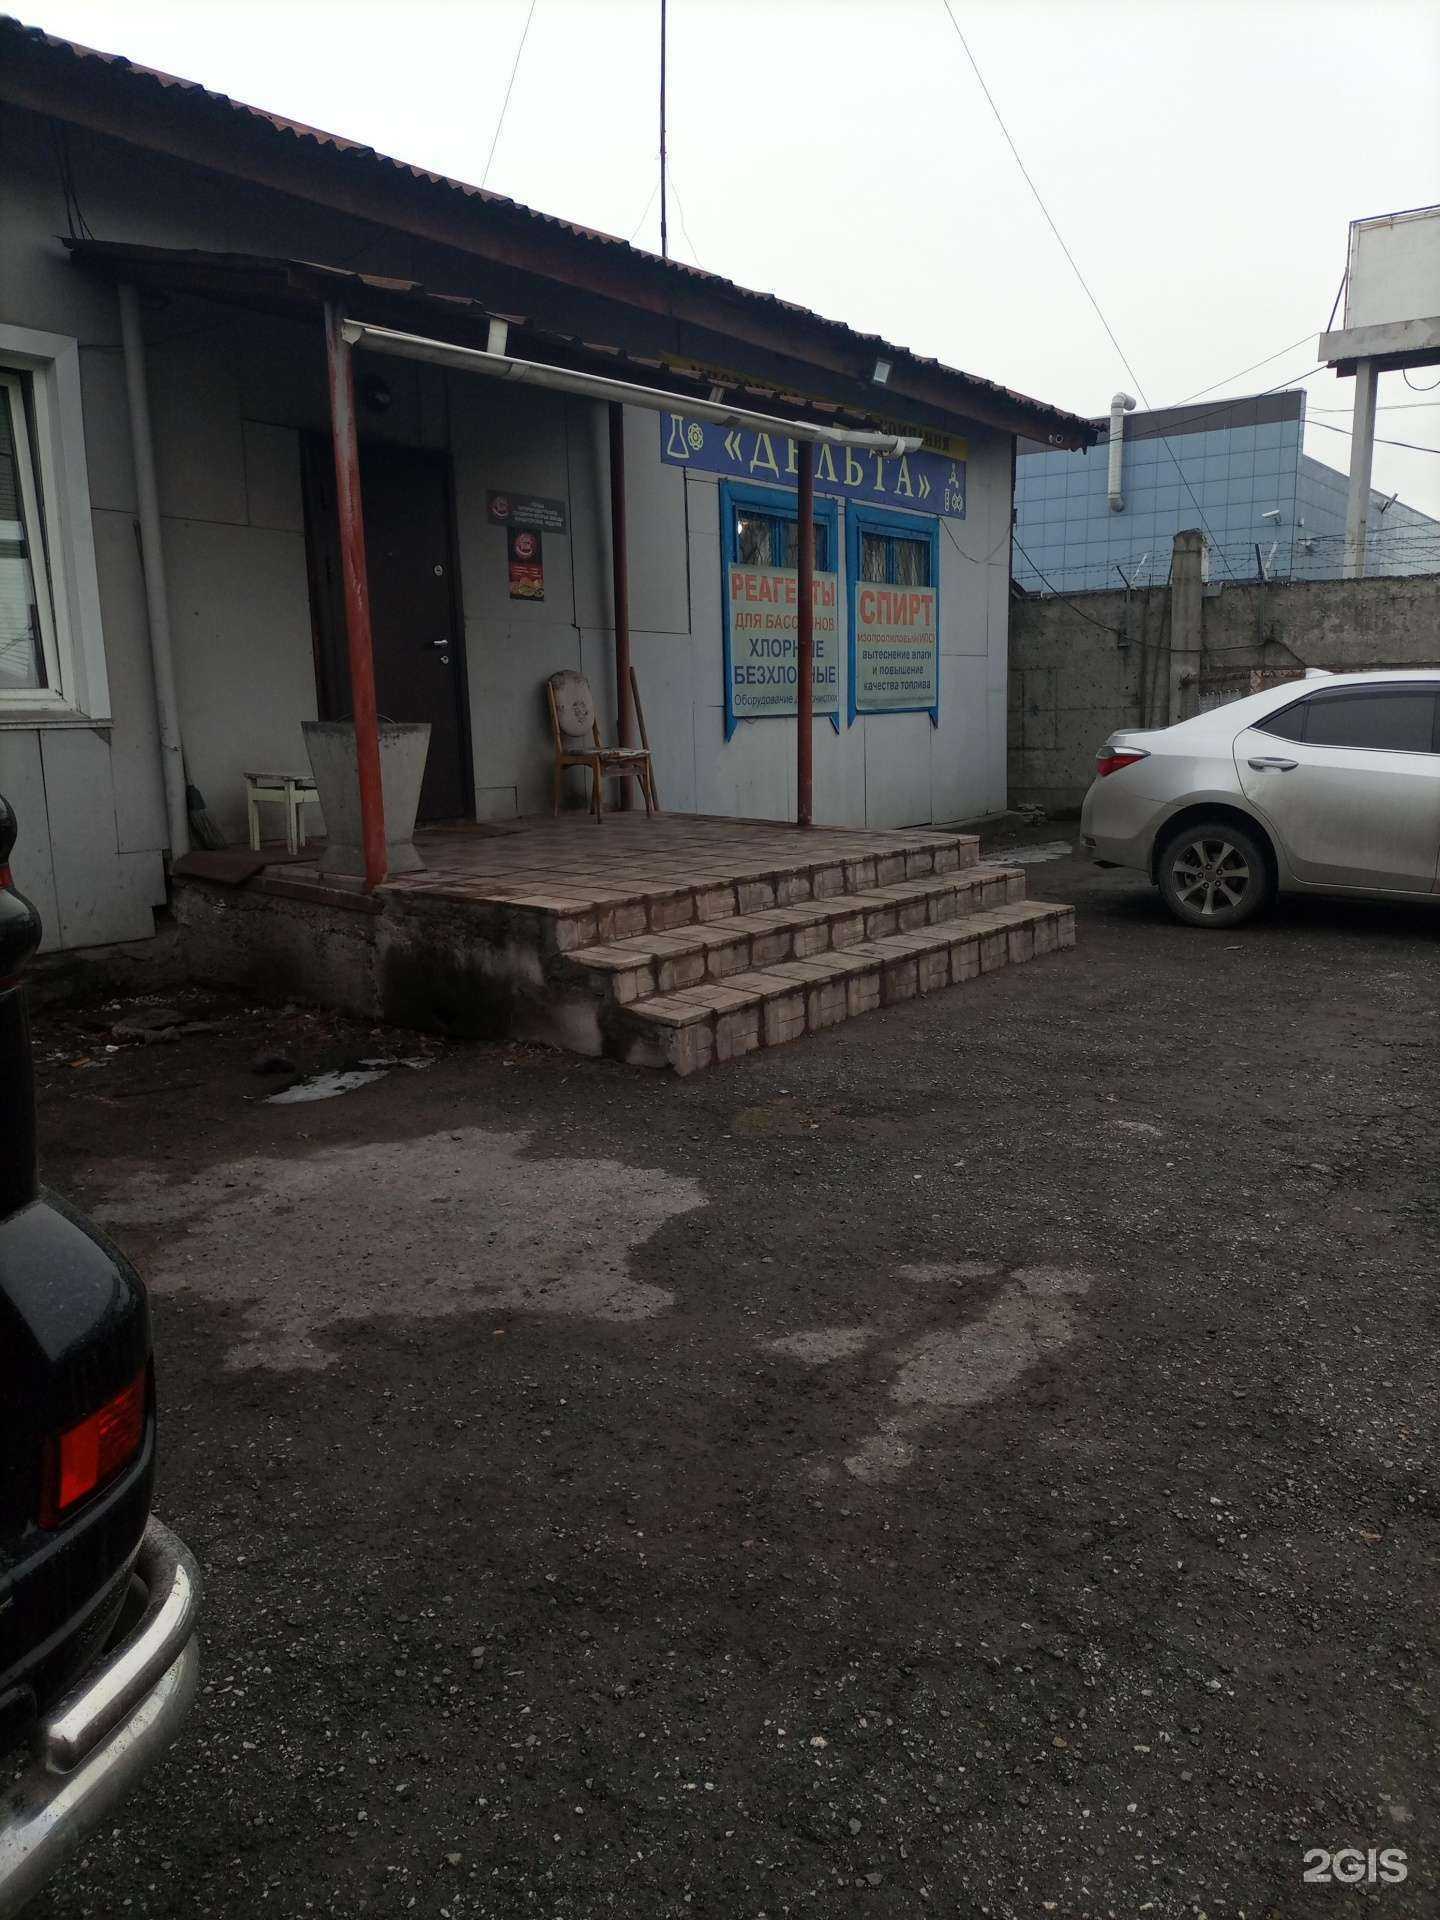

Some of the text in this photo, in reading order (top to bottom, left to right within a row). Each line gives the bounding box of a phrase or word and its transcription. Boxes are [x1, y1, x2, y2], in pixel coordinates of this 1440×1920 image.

[732, 572, 835, 607] РЕАГЕТЫ
[860, 590, 933, 626] СПИРТ
[735, 612, 835, 633] ДЛЯ БАССНОВ
[862, 650, 932, 661] вытеснение влаги
[879, 666, 924, 676] повышение
[863, 679, 931, 691] качества топлива
[734, 693, 793, 708] Оборудование
